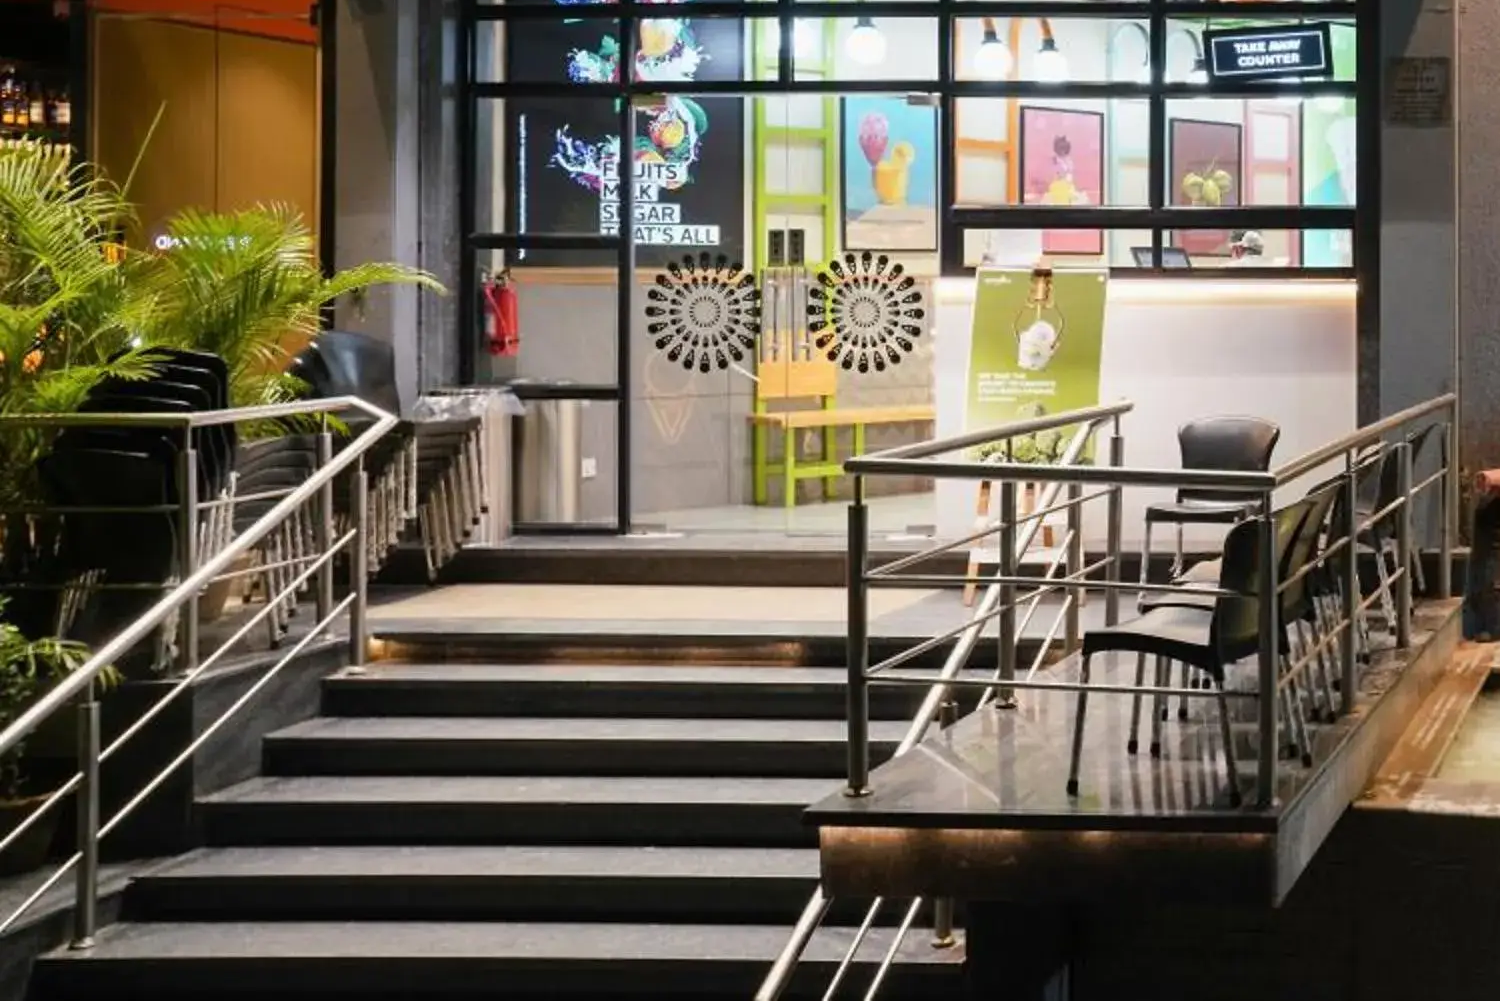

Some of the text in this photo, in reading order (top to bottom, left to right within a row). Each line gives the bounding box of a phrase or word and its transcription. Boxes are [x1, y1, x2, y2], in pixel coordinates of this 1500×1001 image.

[1233, 42, 1267, 54] TAKE
[1237, 53, 1300, 68] COUNTER
[603, 161, 678, 180] FUITS
[603, 183, 652, 200] MK
[603, 204, 675, 221] SGAR
[681, 228, 716, 244] ALL
